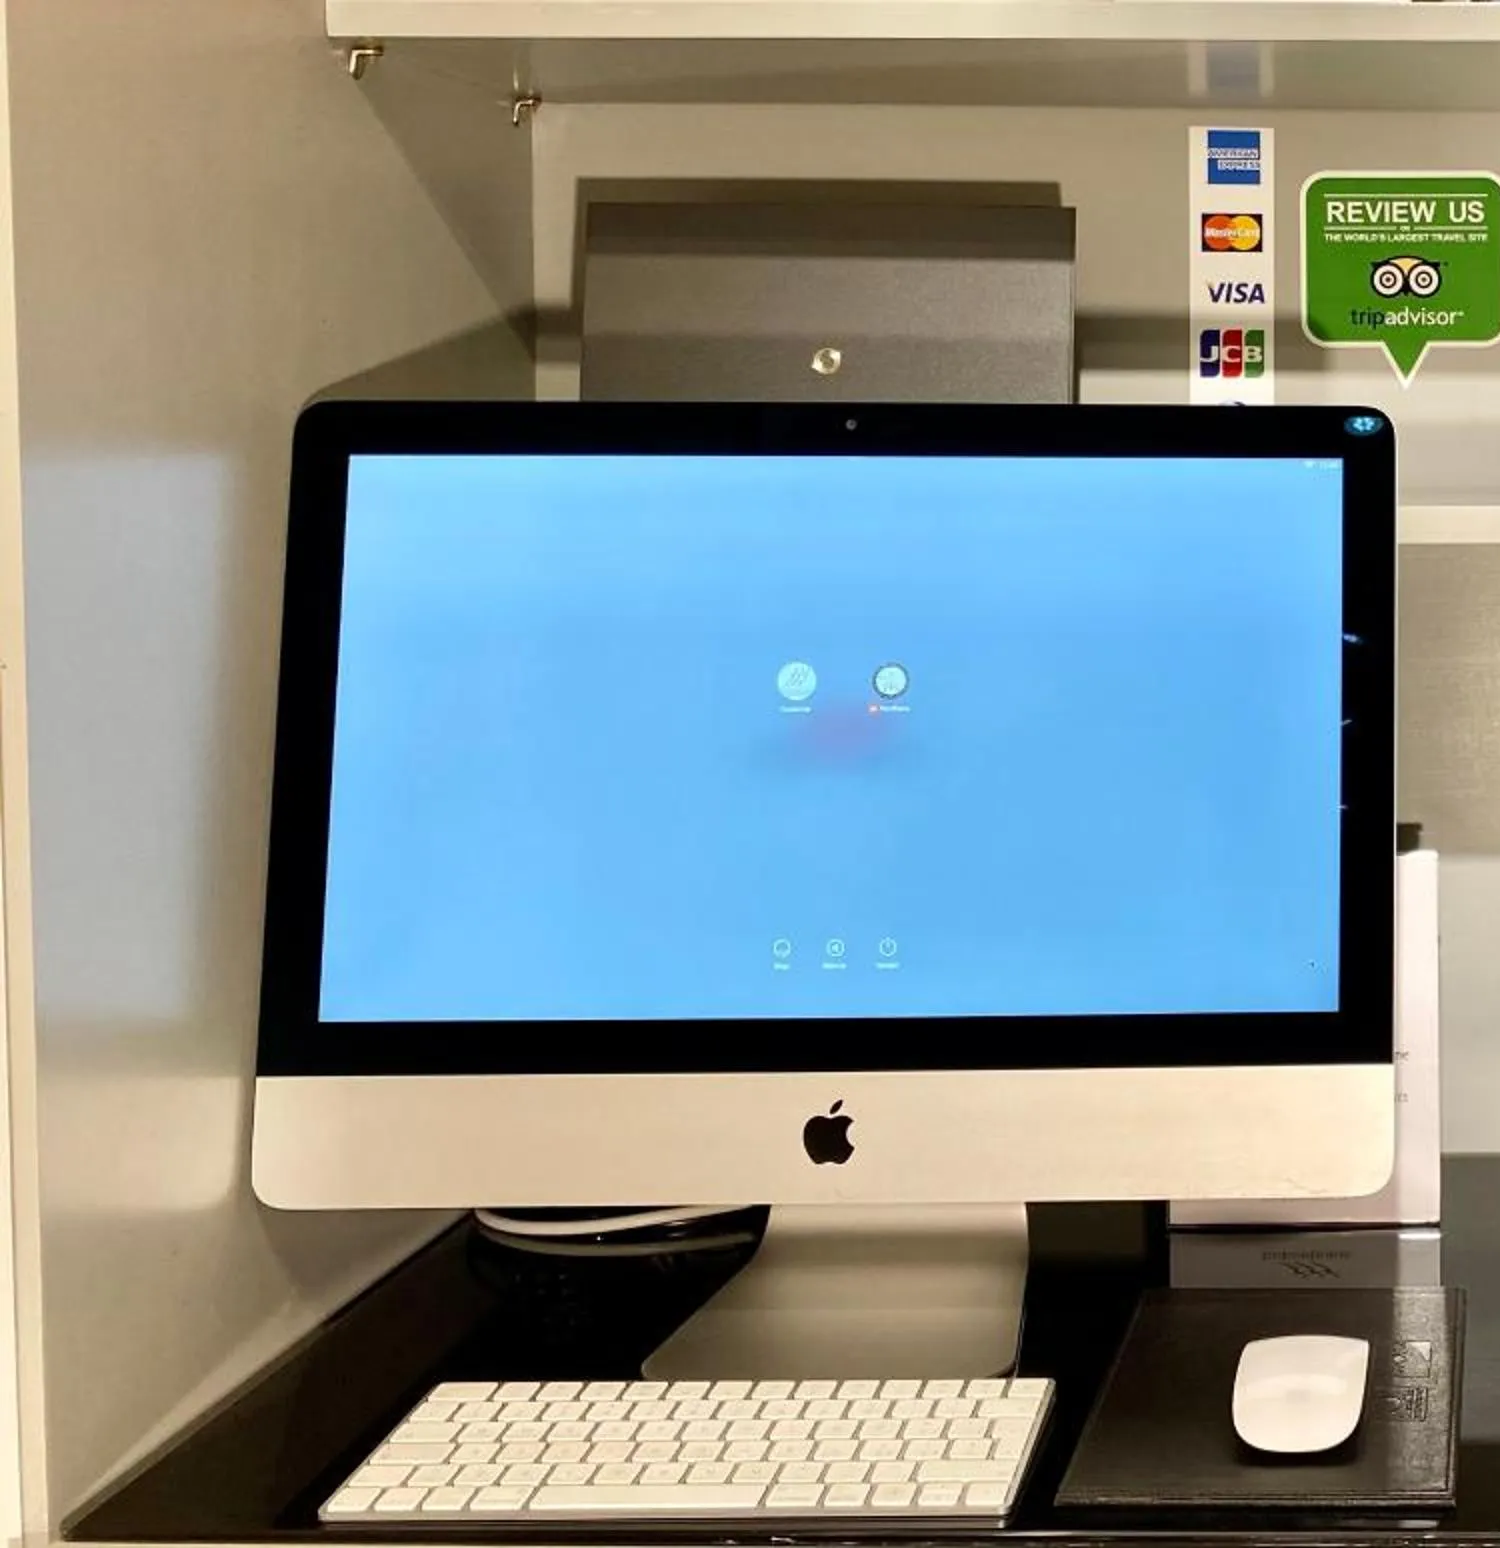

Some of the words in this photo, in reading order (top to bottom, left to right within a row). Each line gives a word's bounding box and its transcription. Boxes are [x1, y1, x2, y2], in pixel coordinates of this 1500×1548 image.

[1327, 201, 1436, 223] REVIEW
[1449, 201, 1485, 223] US
[1325, 233, 1342, 242] THE
[1344, 233, 1386, 242] WORLD'S
[1387, 233, 1429, 242] LARGEST
[1431, 233, 1466, 242] TRAVEL
[1468, 233, 1488, 242] SITE
[1208, 283, 1265, 304] VISA
[1350, 307, 1457, 330] tripadvisor
[1200, 345, 1263, 363] JCB
